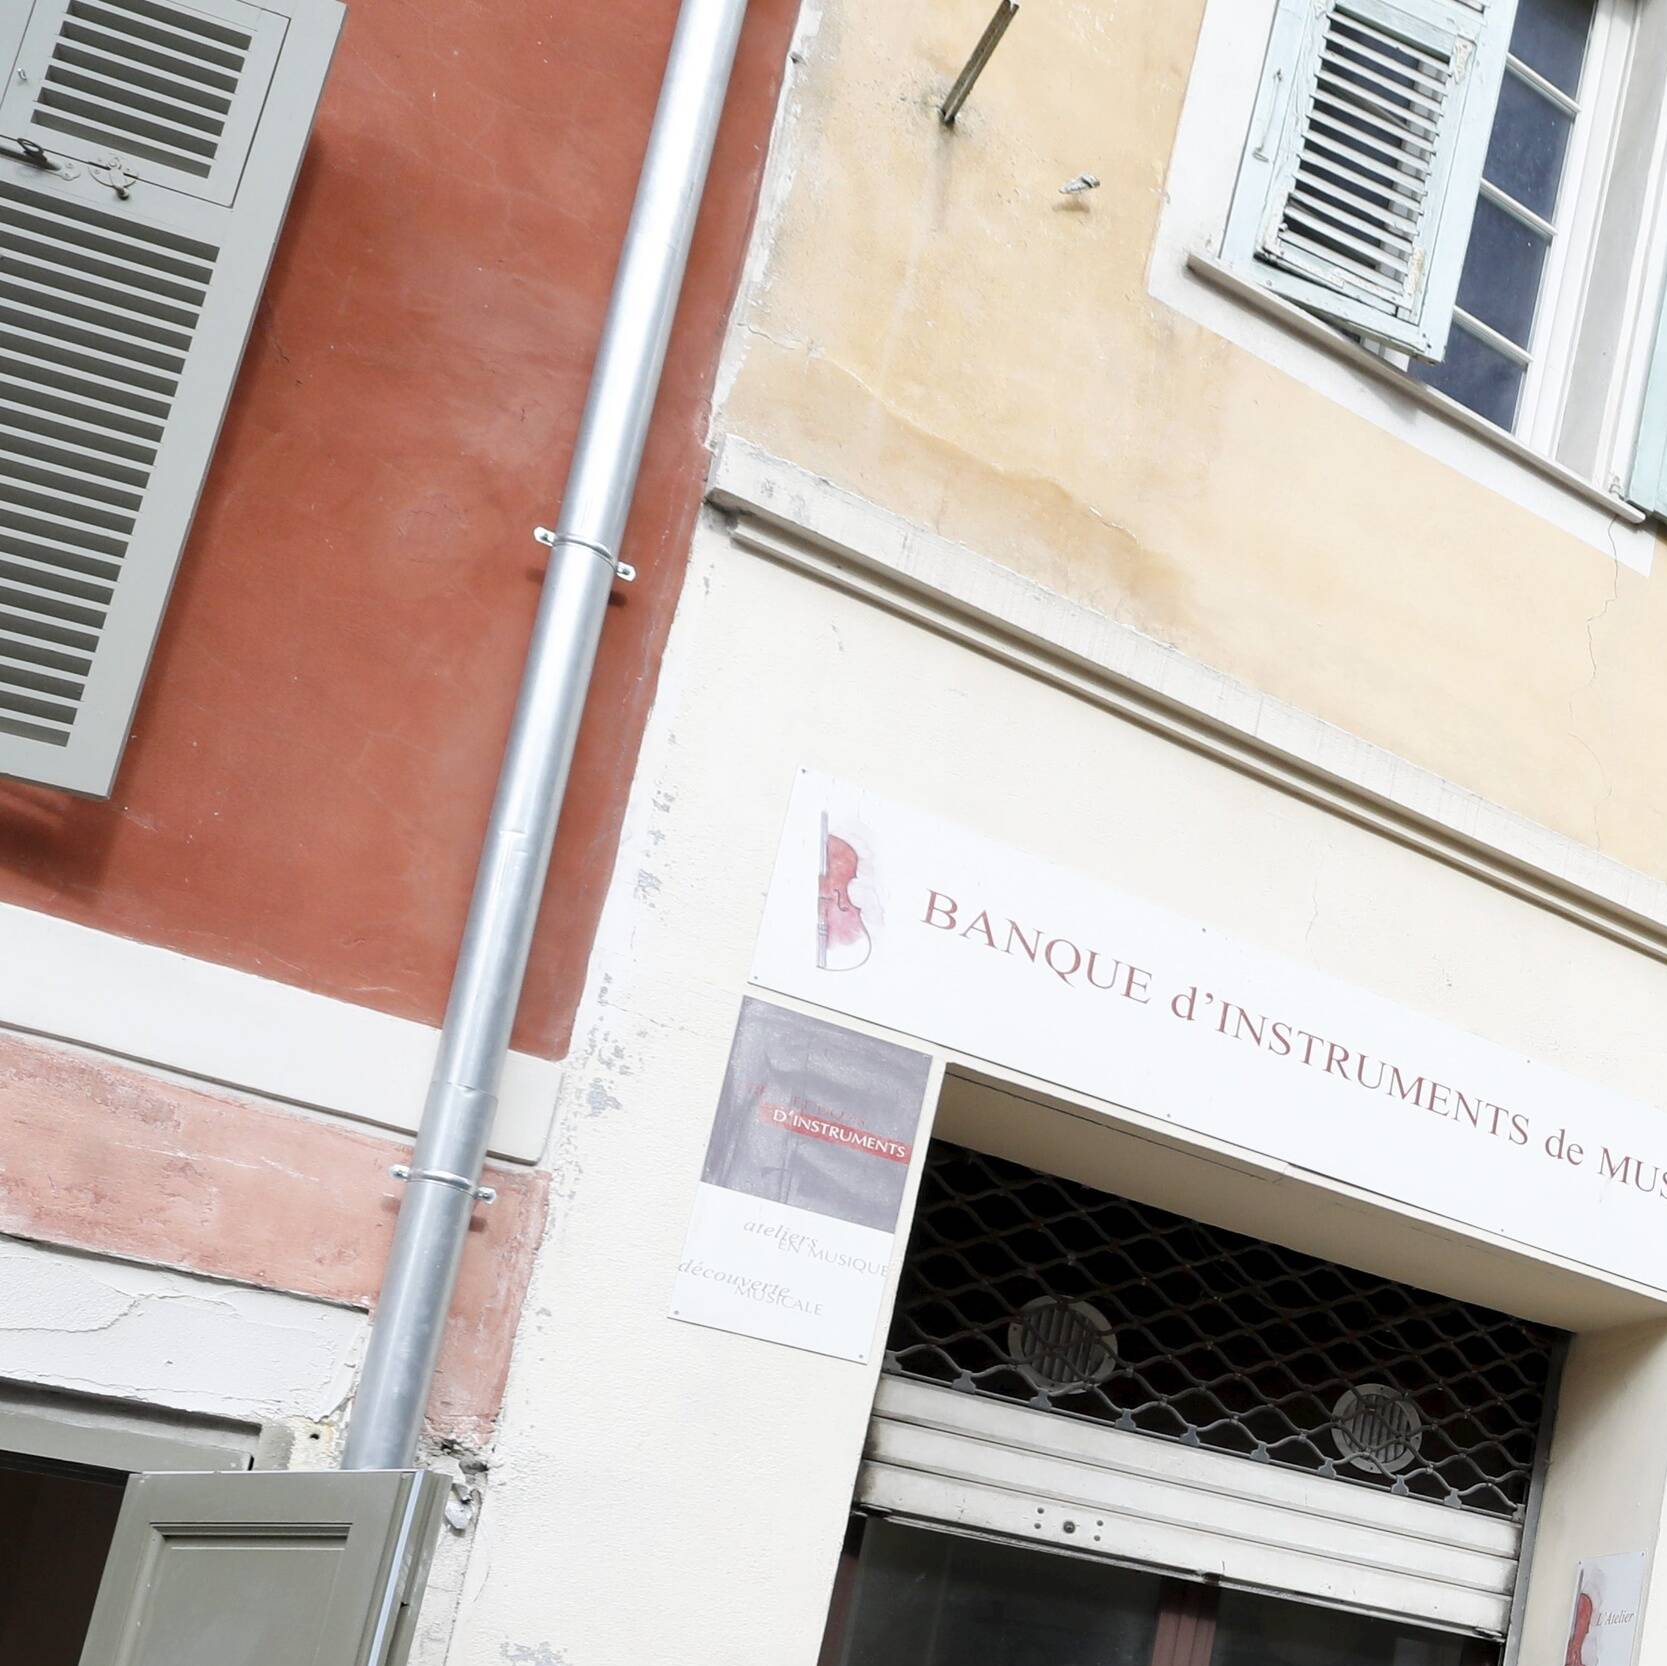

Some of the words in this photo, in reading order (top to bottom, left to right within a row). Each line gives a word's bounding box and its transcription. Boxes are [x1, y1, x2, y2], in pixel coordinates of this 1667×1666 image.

[921, 889, 1152, 1004] BANQUE
[1171, 986, 1529, 1145] d'INSTRUMENTS
[1545, 1129, 1584, 1165] de
[774, 1109, 906, 1158] D'INSTRUMENTS
[743, 1218, 818, 1249] ateliers
[678, 1258, 791, 1298] découverte
[808, 1245, 889, 1277] MUSIQUE
[735, 1285, 823, 1316] MUSICALE
